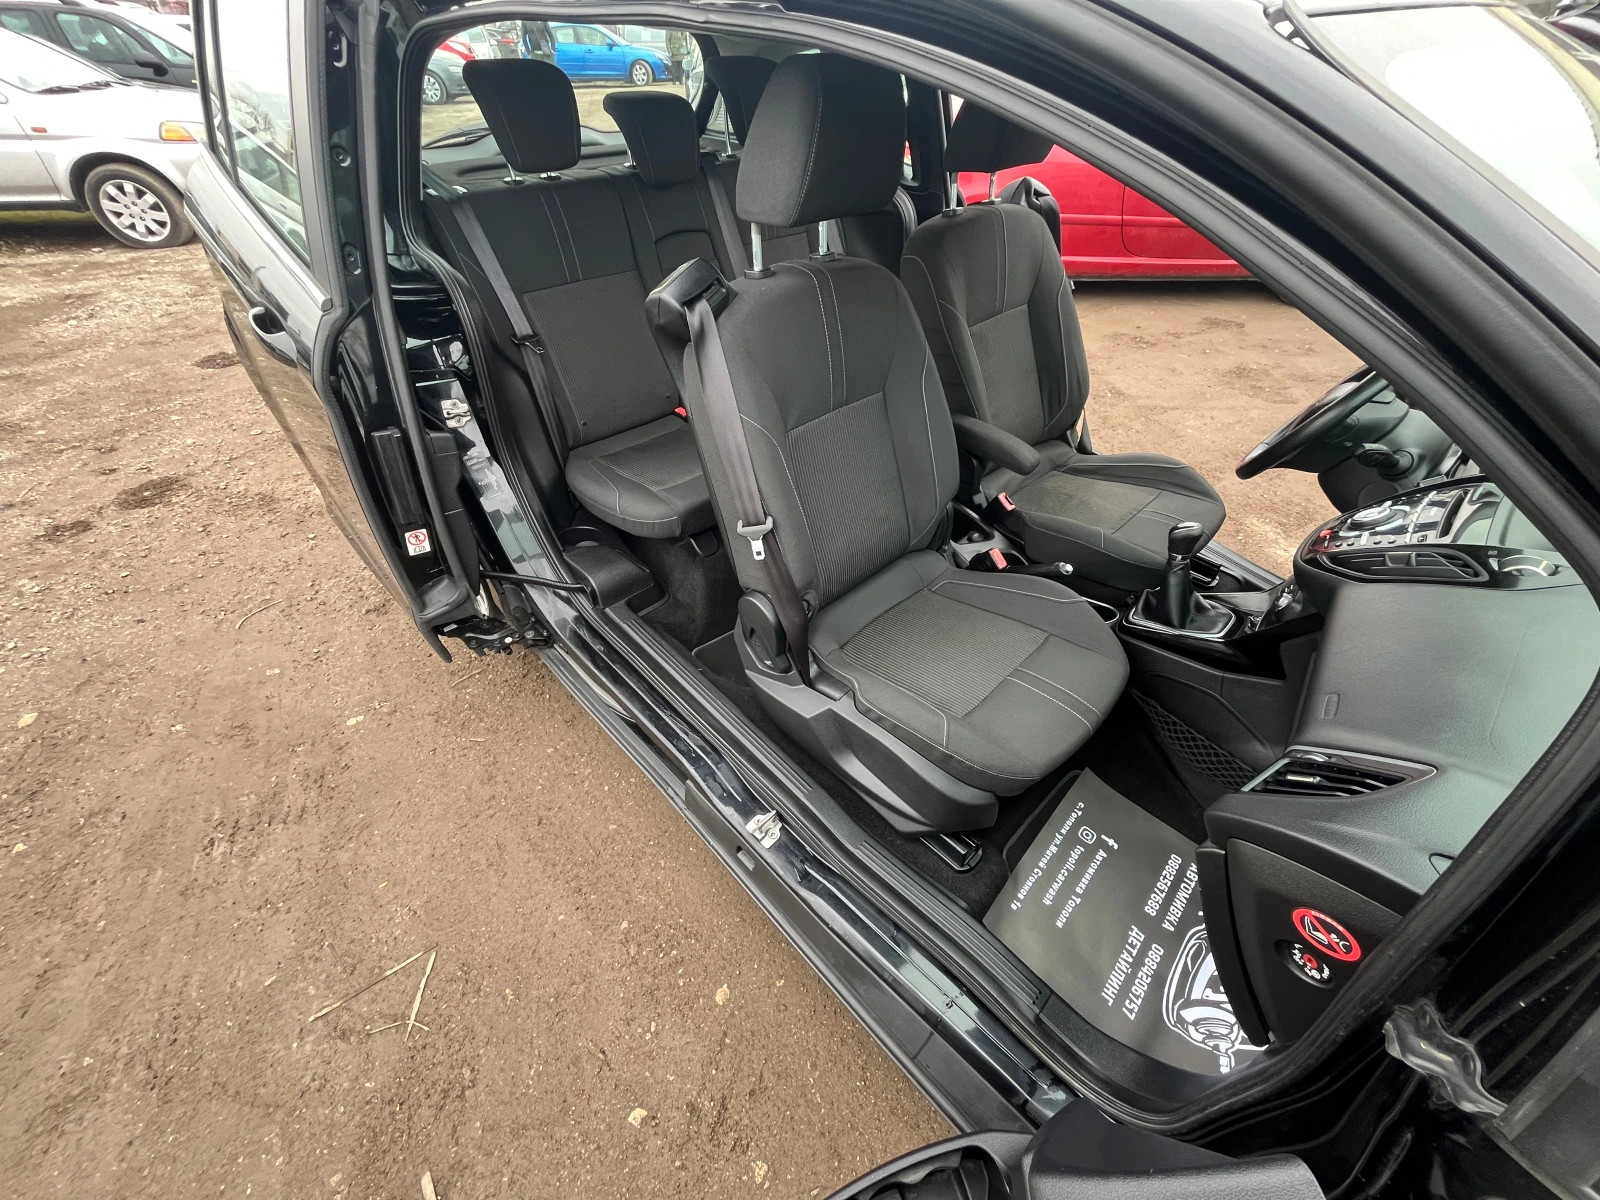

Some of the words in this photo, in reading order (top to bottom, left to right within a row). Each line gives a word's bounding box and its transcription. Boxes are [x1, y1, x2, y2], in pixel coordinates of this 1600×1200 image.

[1018, 869, 1042, 899] Стоянов
[1043, 845, 1085, 906] topoli.carwash
[1076, 849, 1108, 895] Автомивка
[1144, 853, 1183, 918] 0882567688
[1055, 895, 1083, 929] Тополи
[1101, 925, 1146, 1007] ДЕТАЙЛИНГ
[1122, 943, 1165, 1022] 0884206757
